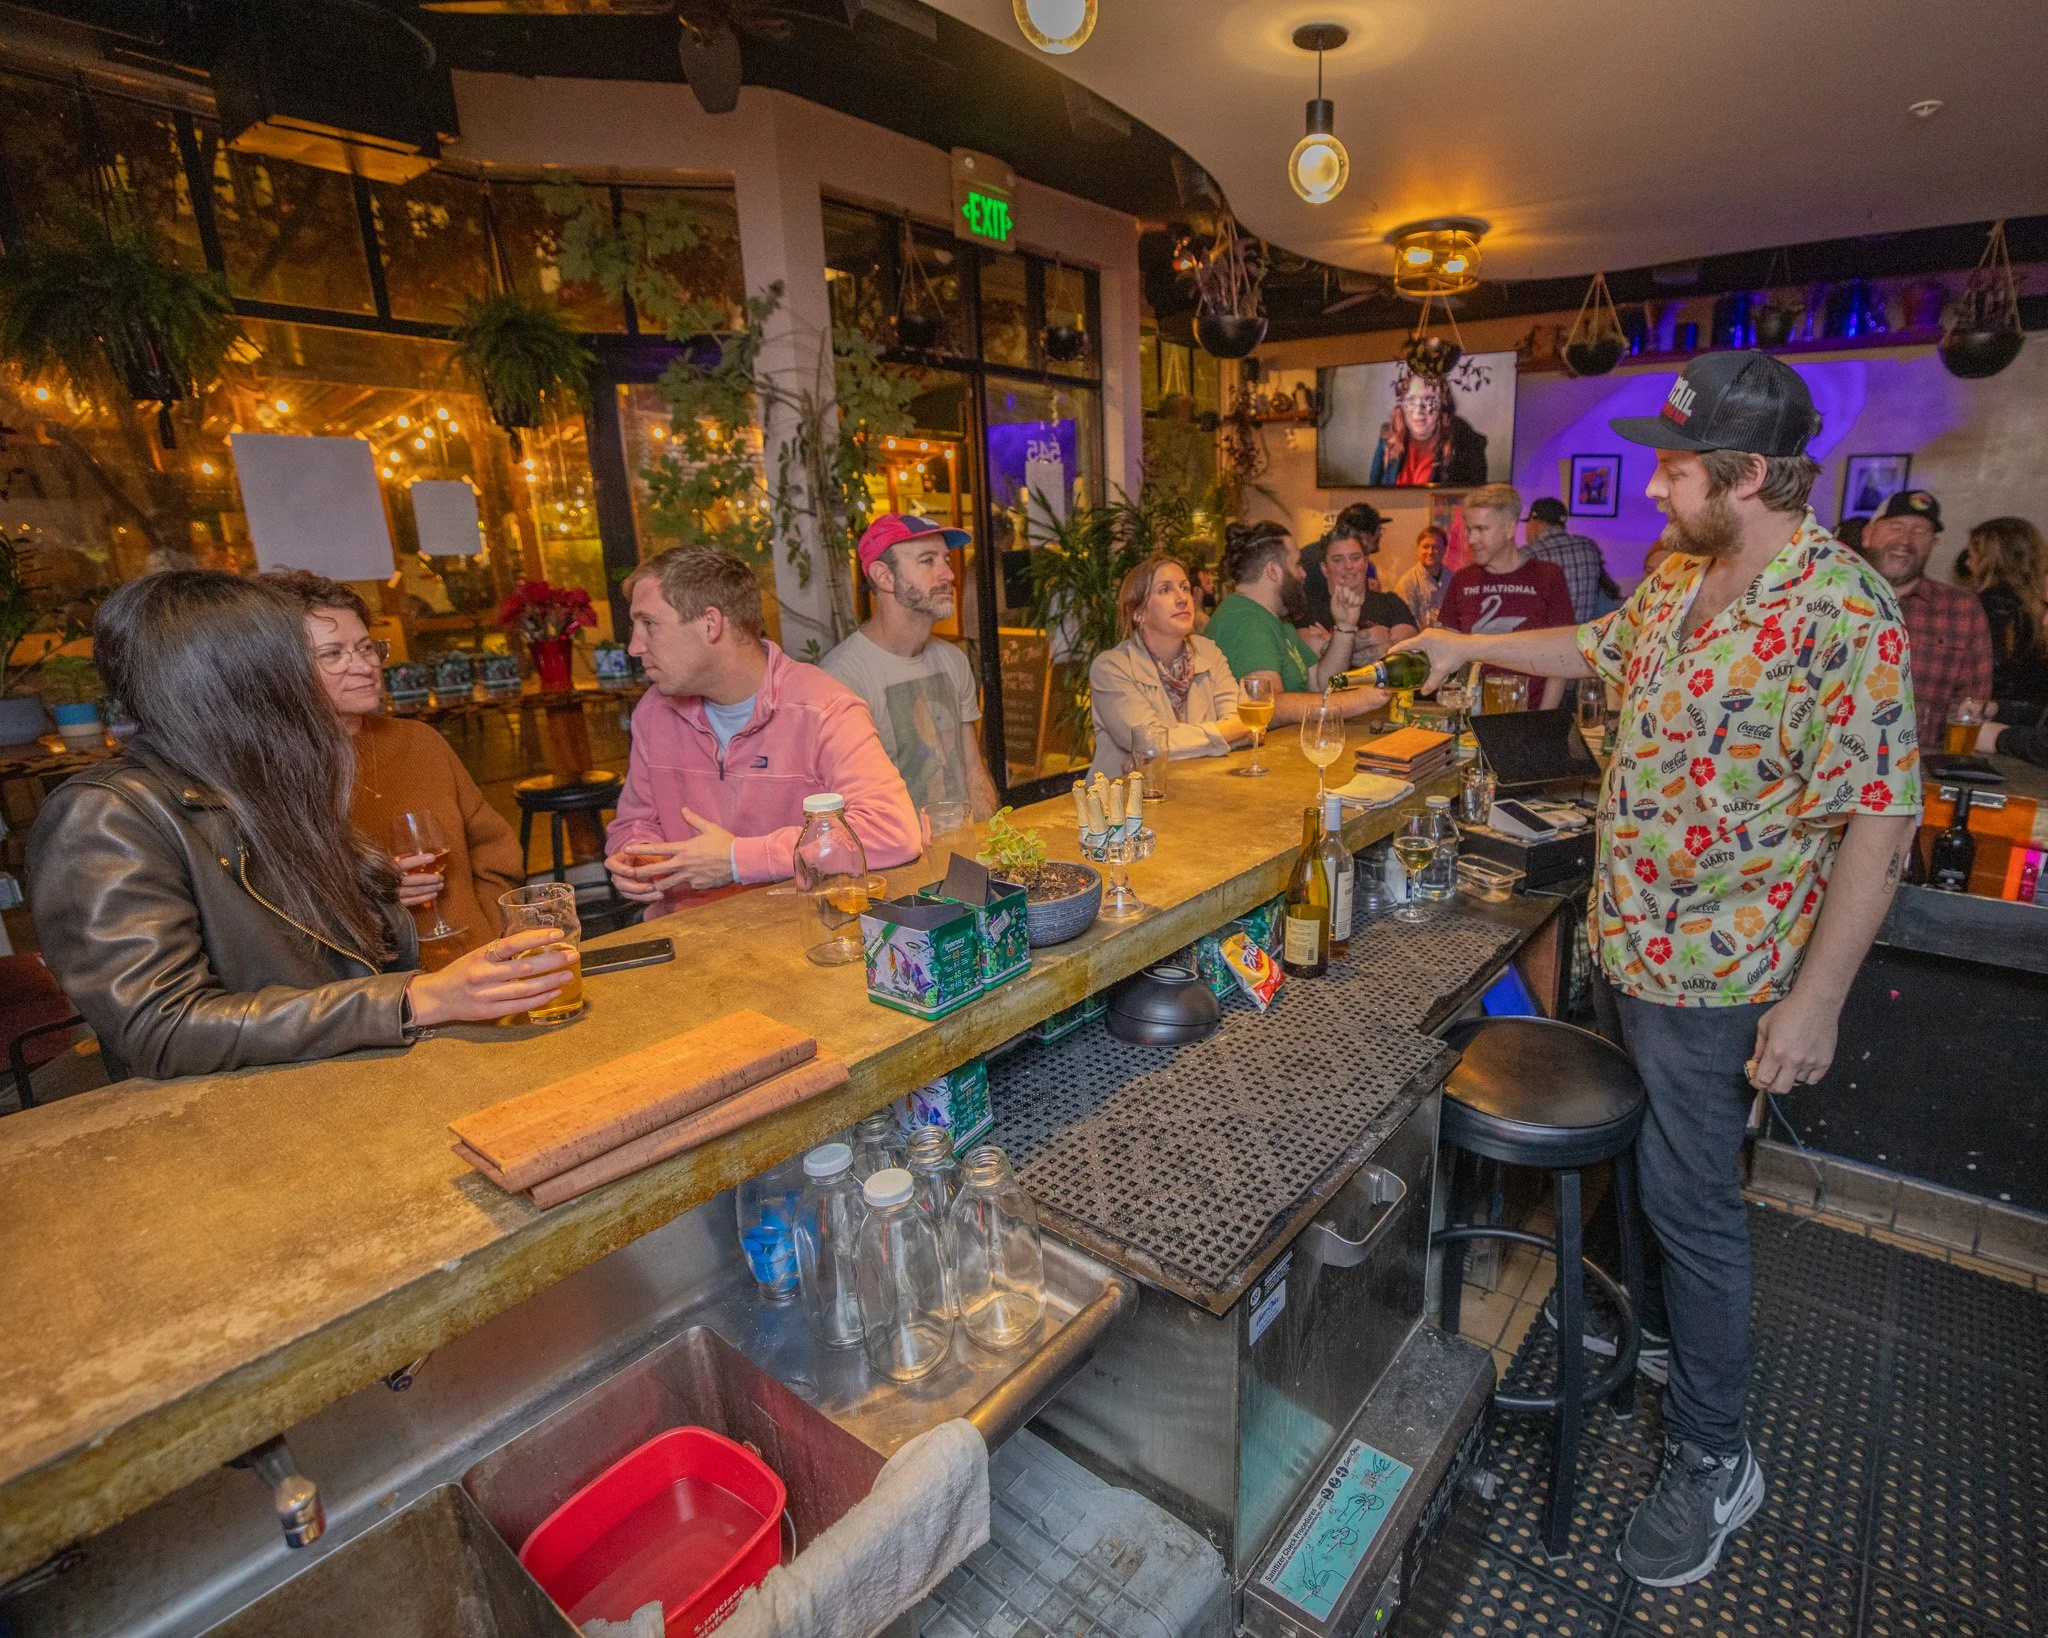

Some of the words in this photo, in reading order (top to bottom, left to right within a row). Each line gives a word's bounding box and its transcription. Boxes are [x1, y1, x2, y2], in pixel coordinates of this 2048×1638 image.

[968, 191, 1008, 241] EXIT
[1463, 585, 1480, 595] THE
[1482, 584, 1537, 595] NATIONAL
[1747, 574, 1763, 605] GIANTS
[1806, 600, 1841, 619] GIANTS
[1766, 665, 1795, 681] GIANT
[1686, 703, 1707, 737] GIANTS
[1789, 697, 1816, 729] GIANTS
[1723, 800, 1760, 814] GIANTS
[1700, 851, 1735, 870] GIANTS
[1640, 888, 1660, 920] GIANTS
[1682, 979, 1718, 991] GIANTS
[1265, 1554, 1286, 1582] Sanitizer
[1283, 1536, 1298, 1556] Check
[1294, 1508, 1318, 1538] Procedures
